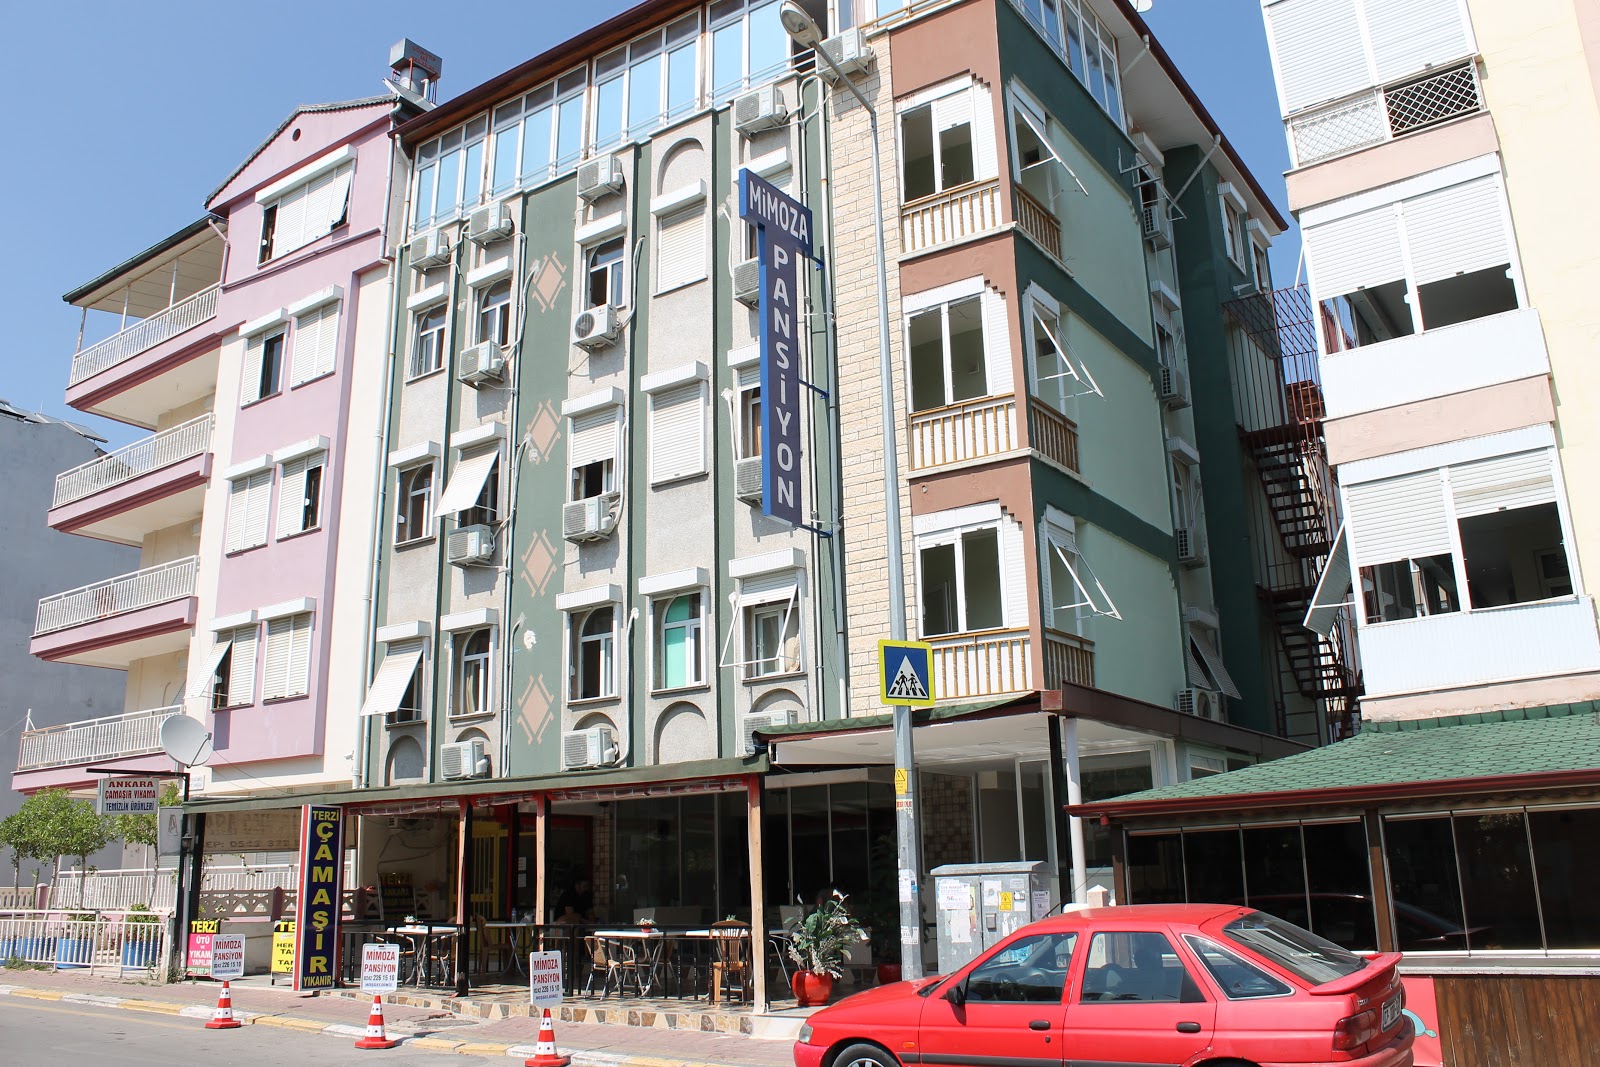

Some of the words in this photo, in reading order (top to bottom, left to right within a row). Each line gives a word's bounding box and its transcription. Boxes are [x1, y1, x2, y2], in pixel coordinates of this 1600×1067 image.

[108, 780, 154, 788] ANKARA
[105, 790, 132, 801] ÇAMAŞIR
[134, 789, 156, 799] YIKAMA
[106, 801, 129, 811] TEMİZLİK
[312, 810, 340, 822] TERZİ
[309, 822, 334, 974] ÇAMAŞIR
[191, 920, 218, 934] TERZİ
[195, 935, 210, 945] ÜTÜ
[215, 939, 242, 949] MİMOZA
[189, 949, 212, 958] YIKAM
[213, 951, 243, 961] PANSİYON
[366, 949, 395, 960] MİMOZA
[364, 962, 396, 972] PANSİYON
[534, 958, 558, 970] MİMOZA
[303, 975, 332, 987] YIKANIR
[533, 972, 560, 984] PANSİYON
